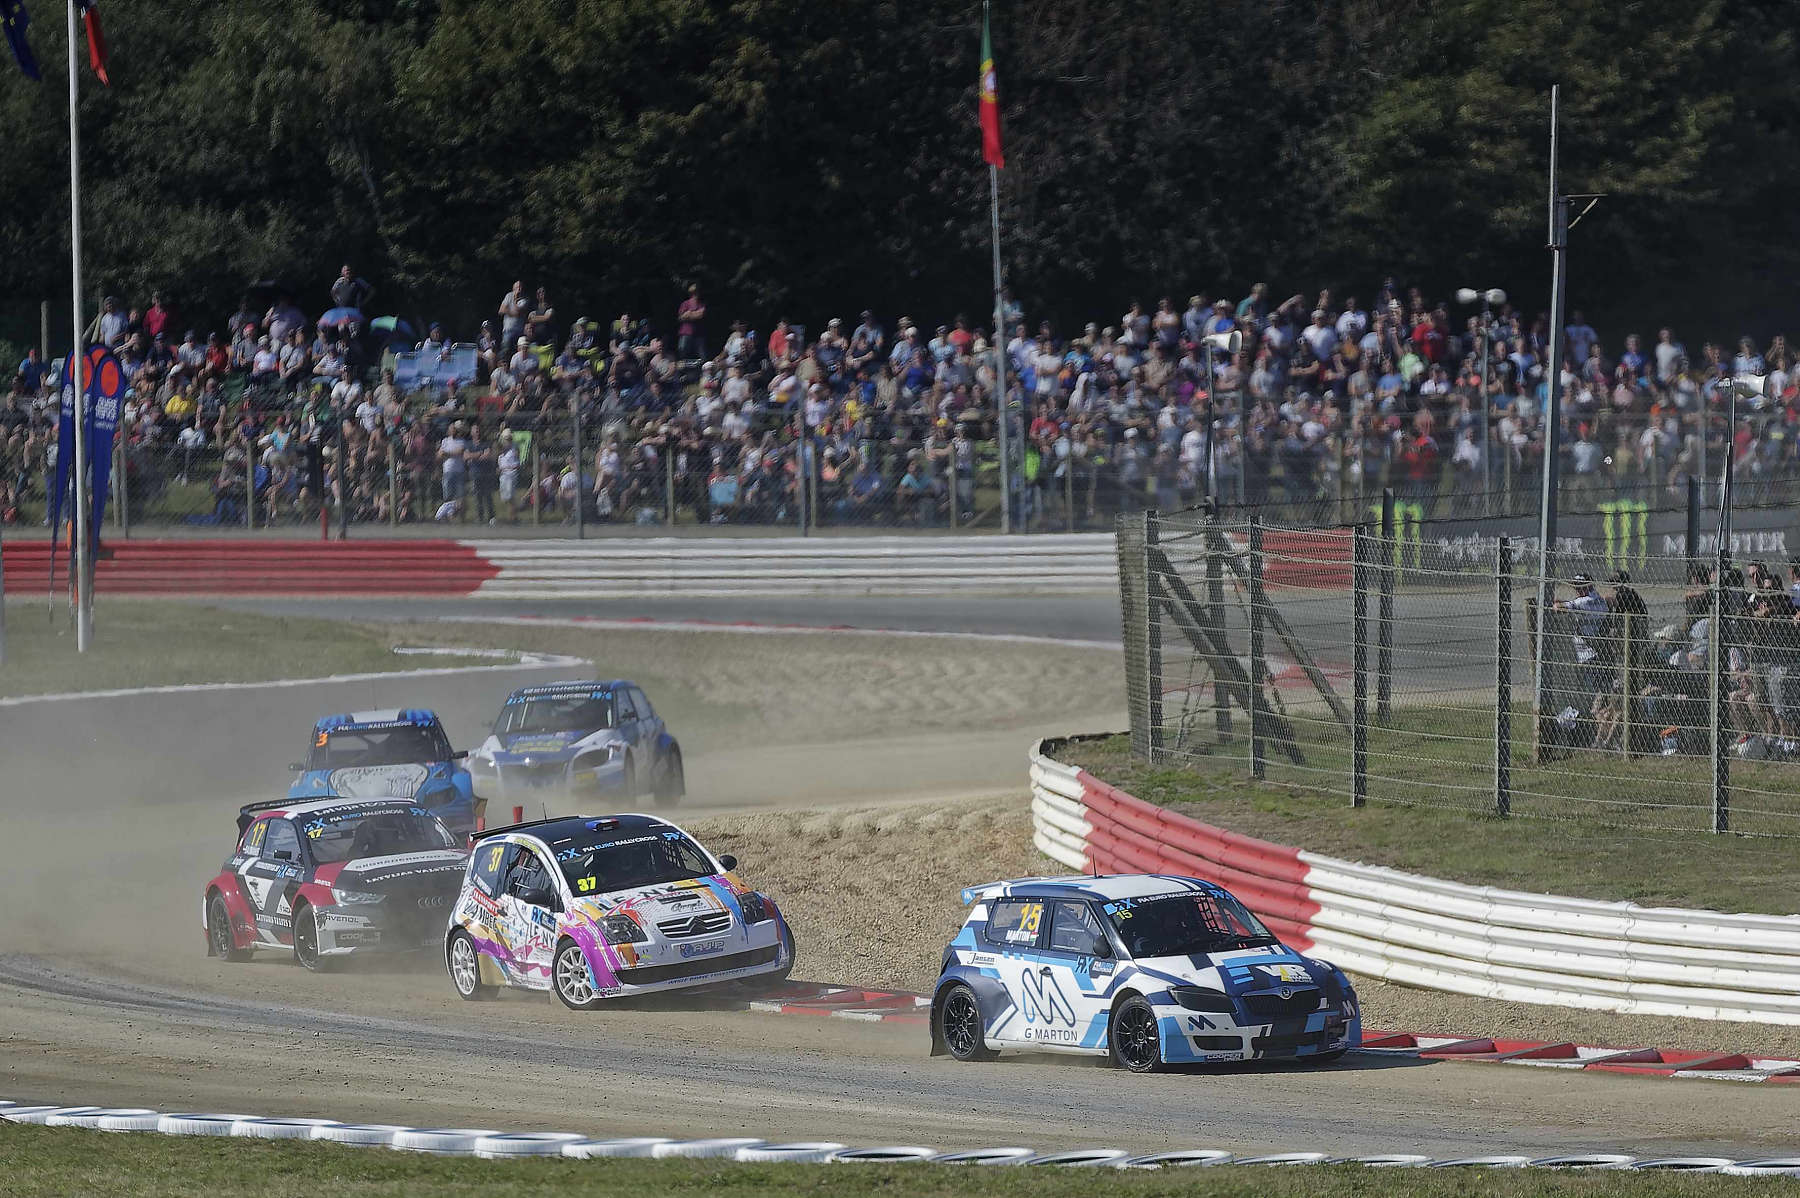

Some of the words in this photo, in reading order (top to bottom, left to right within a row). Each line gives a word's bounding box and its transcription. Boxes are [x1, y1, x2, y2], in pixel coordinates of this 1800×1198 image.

[315, 733, 328, 747] 3
[251, 822, 267, 847] 17
[307, 828, 324, 839] 17
[615, 835, 659, 846] RALLYCROSS
[488, 846, 505, 872] 37
[577, 877, 596, 892] 37
[1167, 891, 1206, 900] RALLYCROSS
[1020, 903, 1043, 930] 15
[1116, 909, 1133, 920] 15
[1024, 1028, 1032, 1039] G
[1035, 1028, 1078, 1041] MARTON
